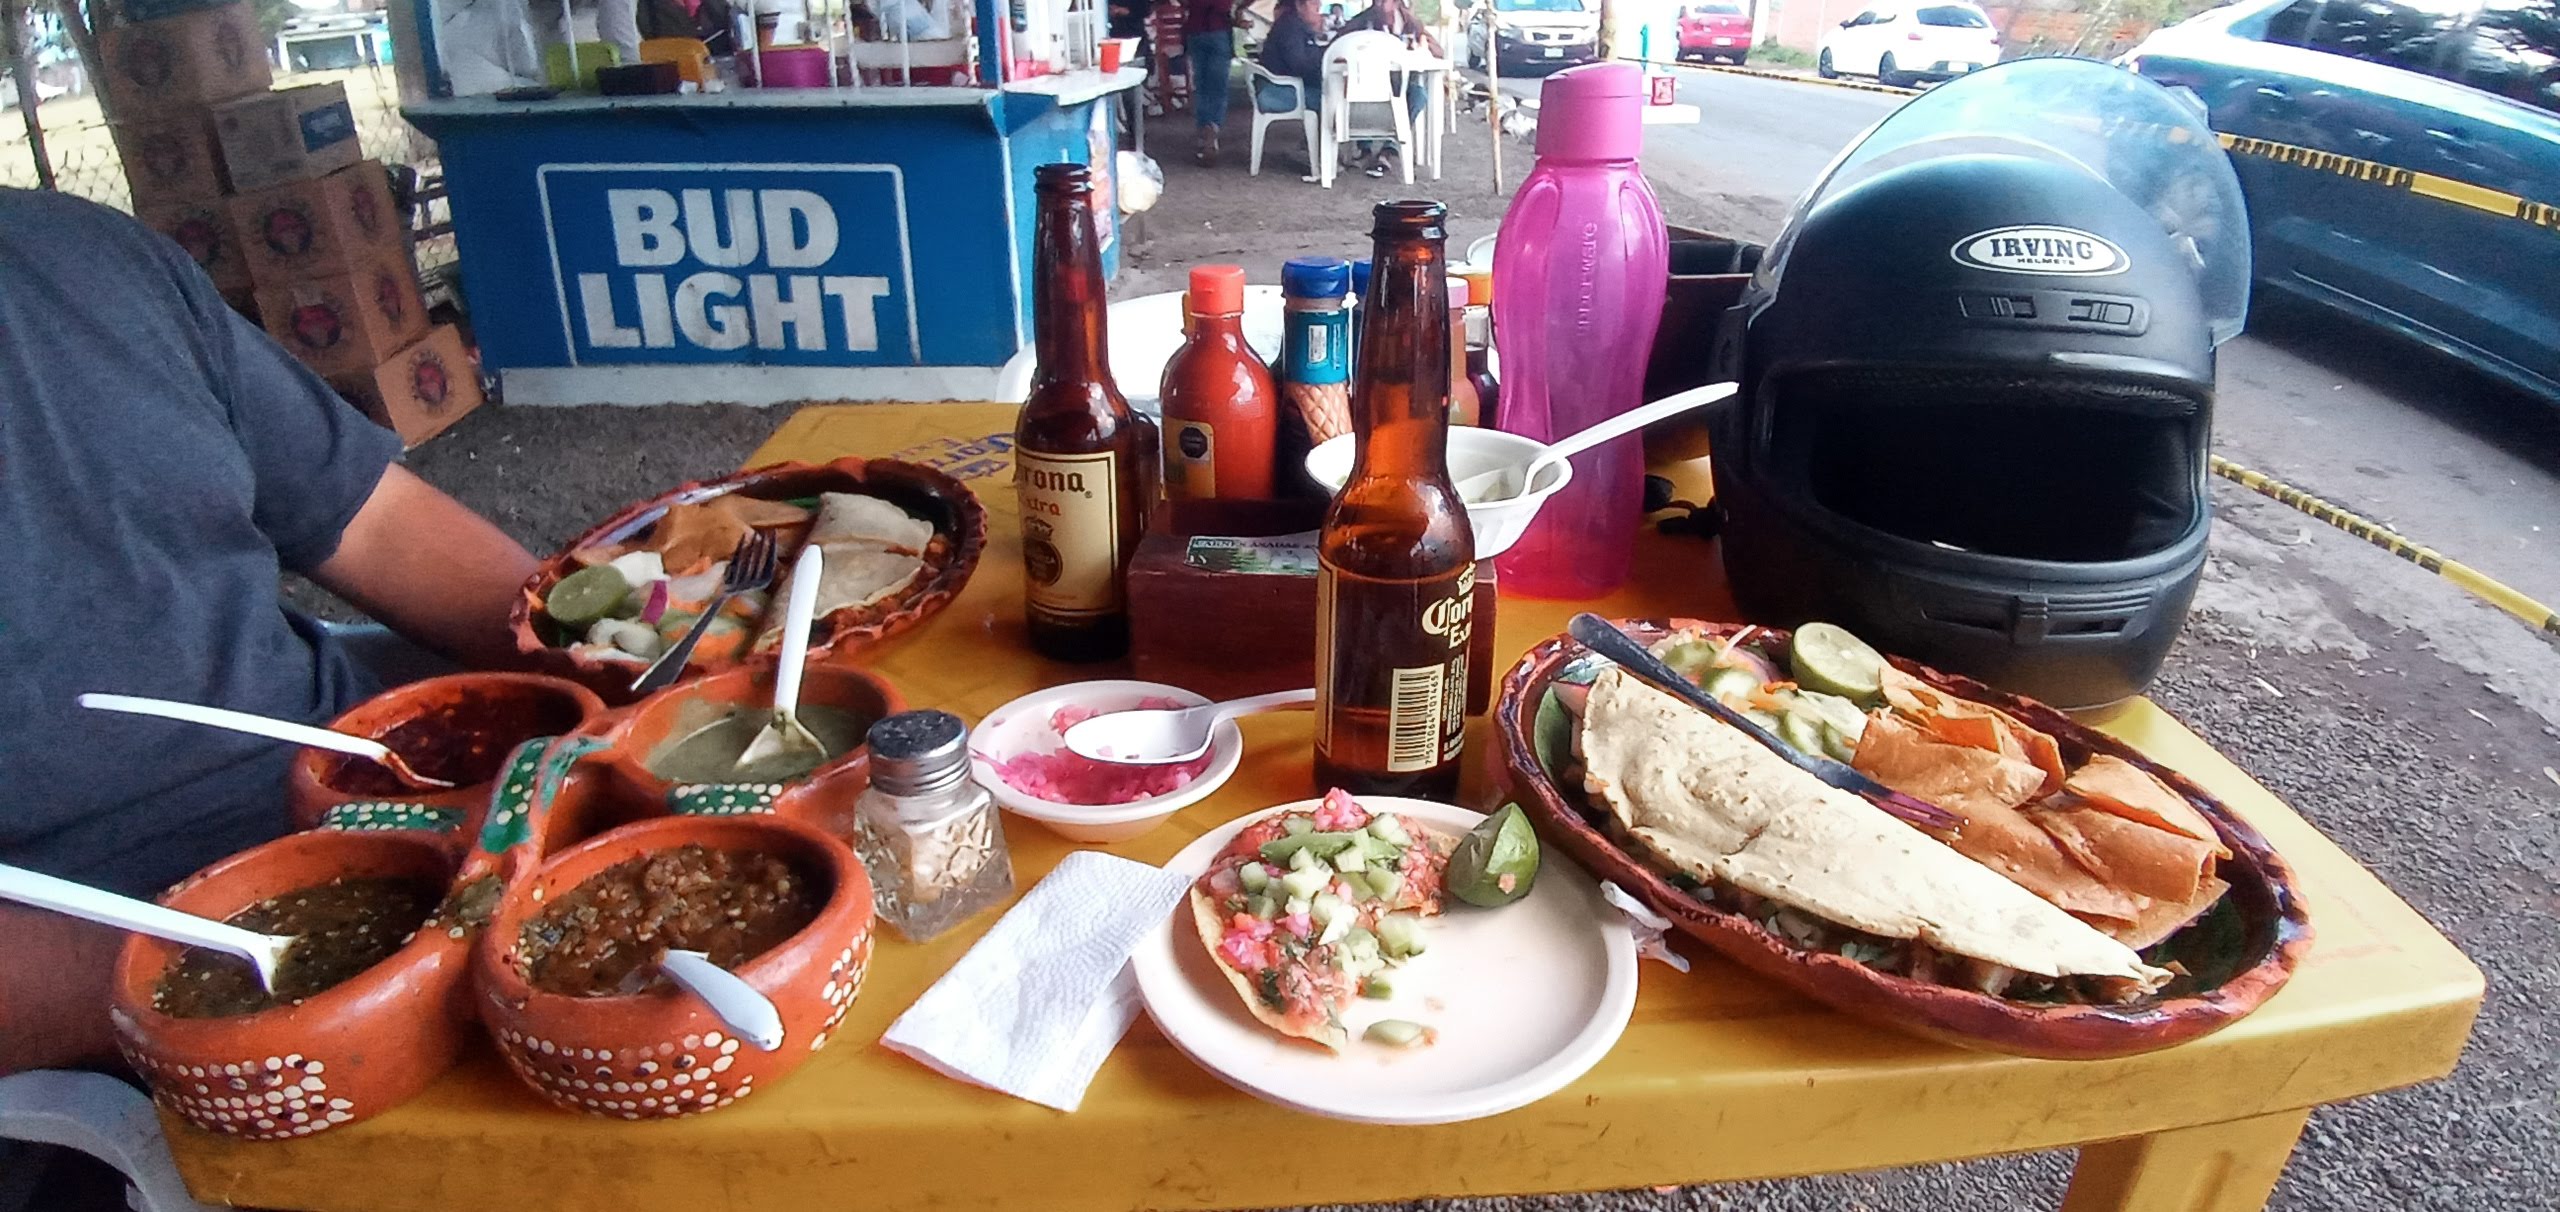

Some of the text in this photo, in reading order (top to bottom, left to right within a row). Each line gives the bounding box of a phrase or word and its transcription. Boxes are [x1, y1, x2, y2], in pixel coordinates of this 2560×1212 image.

[608, 189, 839, 268] BUD
[1989, 238, 2093, 260] IRVING
[2017, 258, 2076, 266] HELMETS
[578, 271, 889, 352] LIGHT
[1022, 465, 1086, 492] rona
